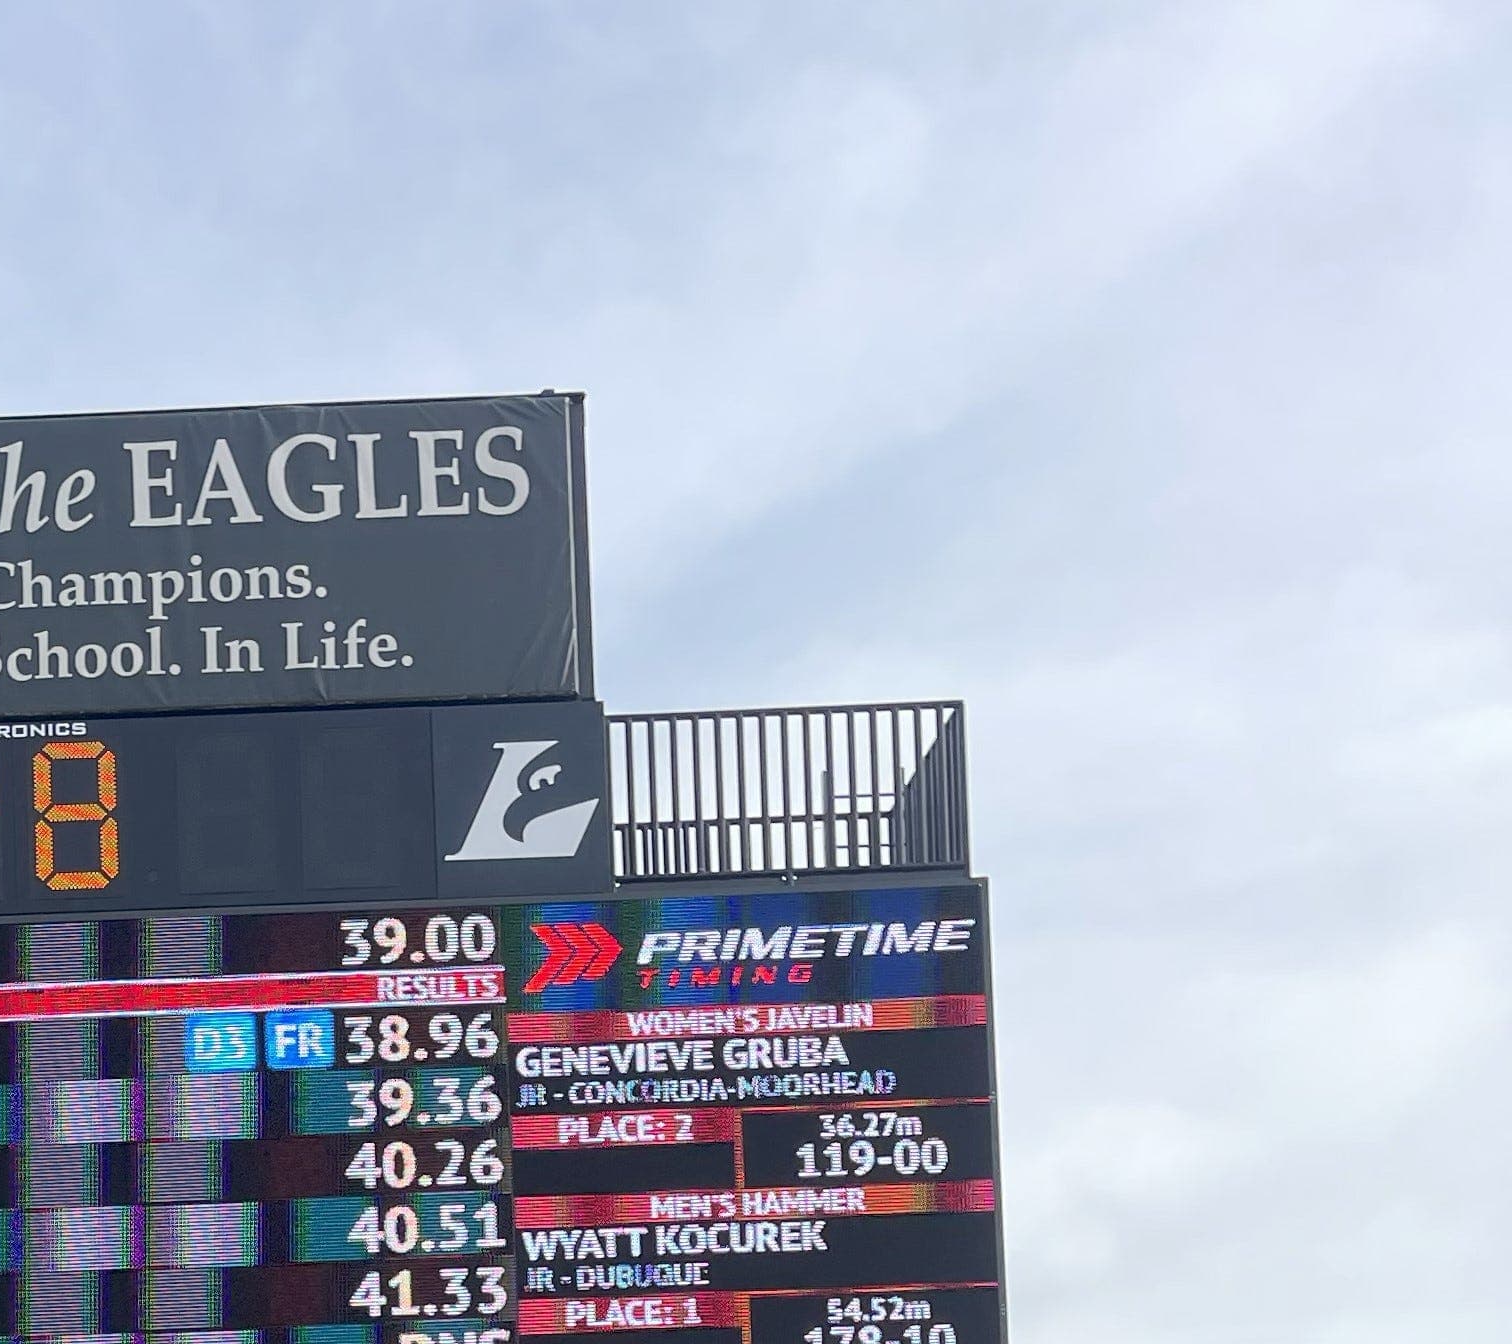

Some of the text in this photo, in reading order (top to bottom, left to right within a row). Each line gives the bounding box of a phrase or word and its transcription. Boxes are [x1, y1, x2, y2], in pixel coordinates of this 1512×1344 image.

[125, 426, 531, 529] EAGLES
[201, 626, 264, 674] In
[282, 618, 415, 672] Life.
[340, 913, 496, 966] 39.00
[637, 919, 976, 964] PRIMETIME
[376, 973, 498, 1001] RESULTS
[638, 964, 813, 989] TIMING
[275, 1023, 323, 1058] FR
[345, 1012, 499, 1063] 38.96
[626, 1003, 873, 1037] WOMEN'S JAVELIN
[515, 1036, 850, 1078] GENEVIEVE GRUBA
[347, 1075, 502, 1128] 39.36
[558, 1115, 694, 1144] PLACE: 2
[819, 1112, 923, 1138] 36.27m
[346, 1139, 504, 1189] 40.26
[796, 1139, 949, 1179] 119-00
[650, 1188, 865, 1220] MEN'S HAMMER
[348, 1200, 506, 1254] 40.51
[522, 1220, 828, 1261] WYATT KOCUREK
[350, 1267, 507, 1318] 41.33
[577, 1262, 709, 1291] DUBUQUE
[565, 1298, 702, 1327] PLACE: 1
[827, 1297, 932, 1323] 54.52m
